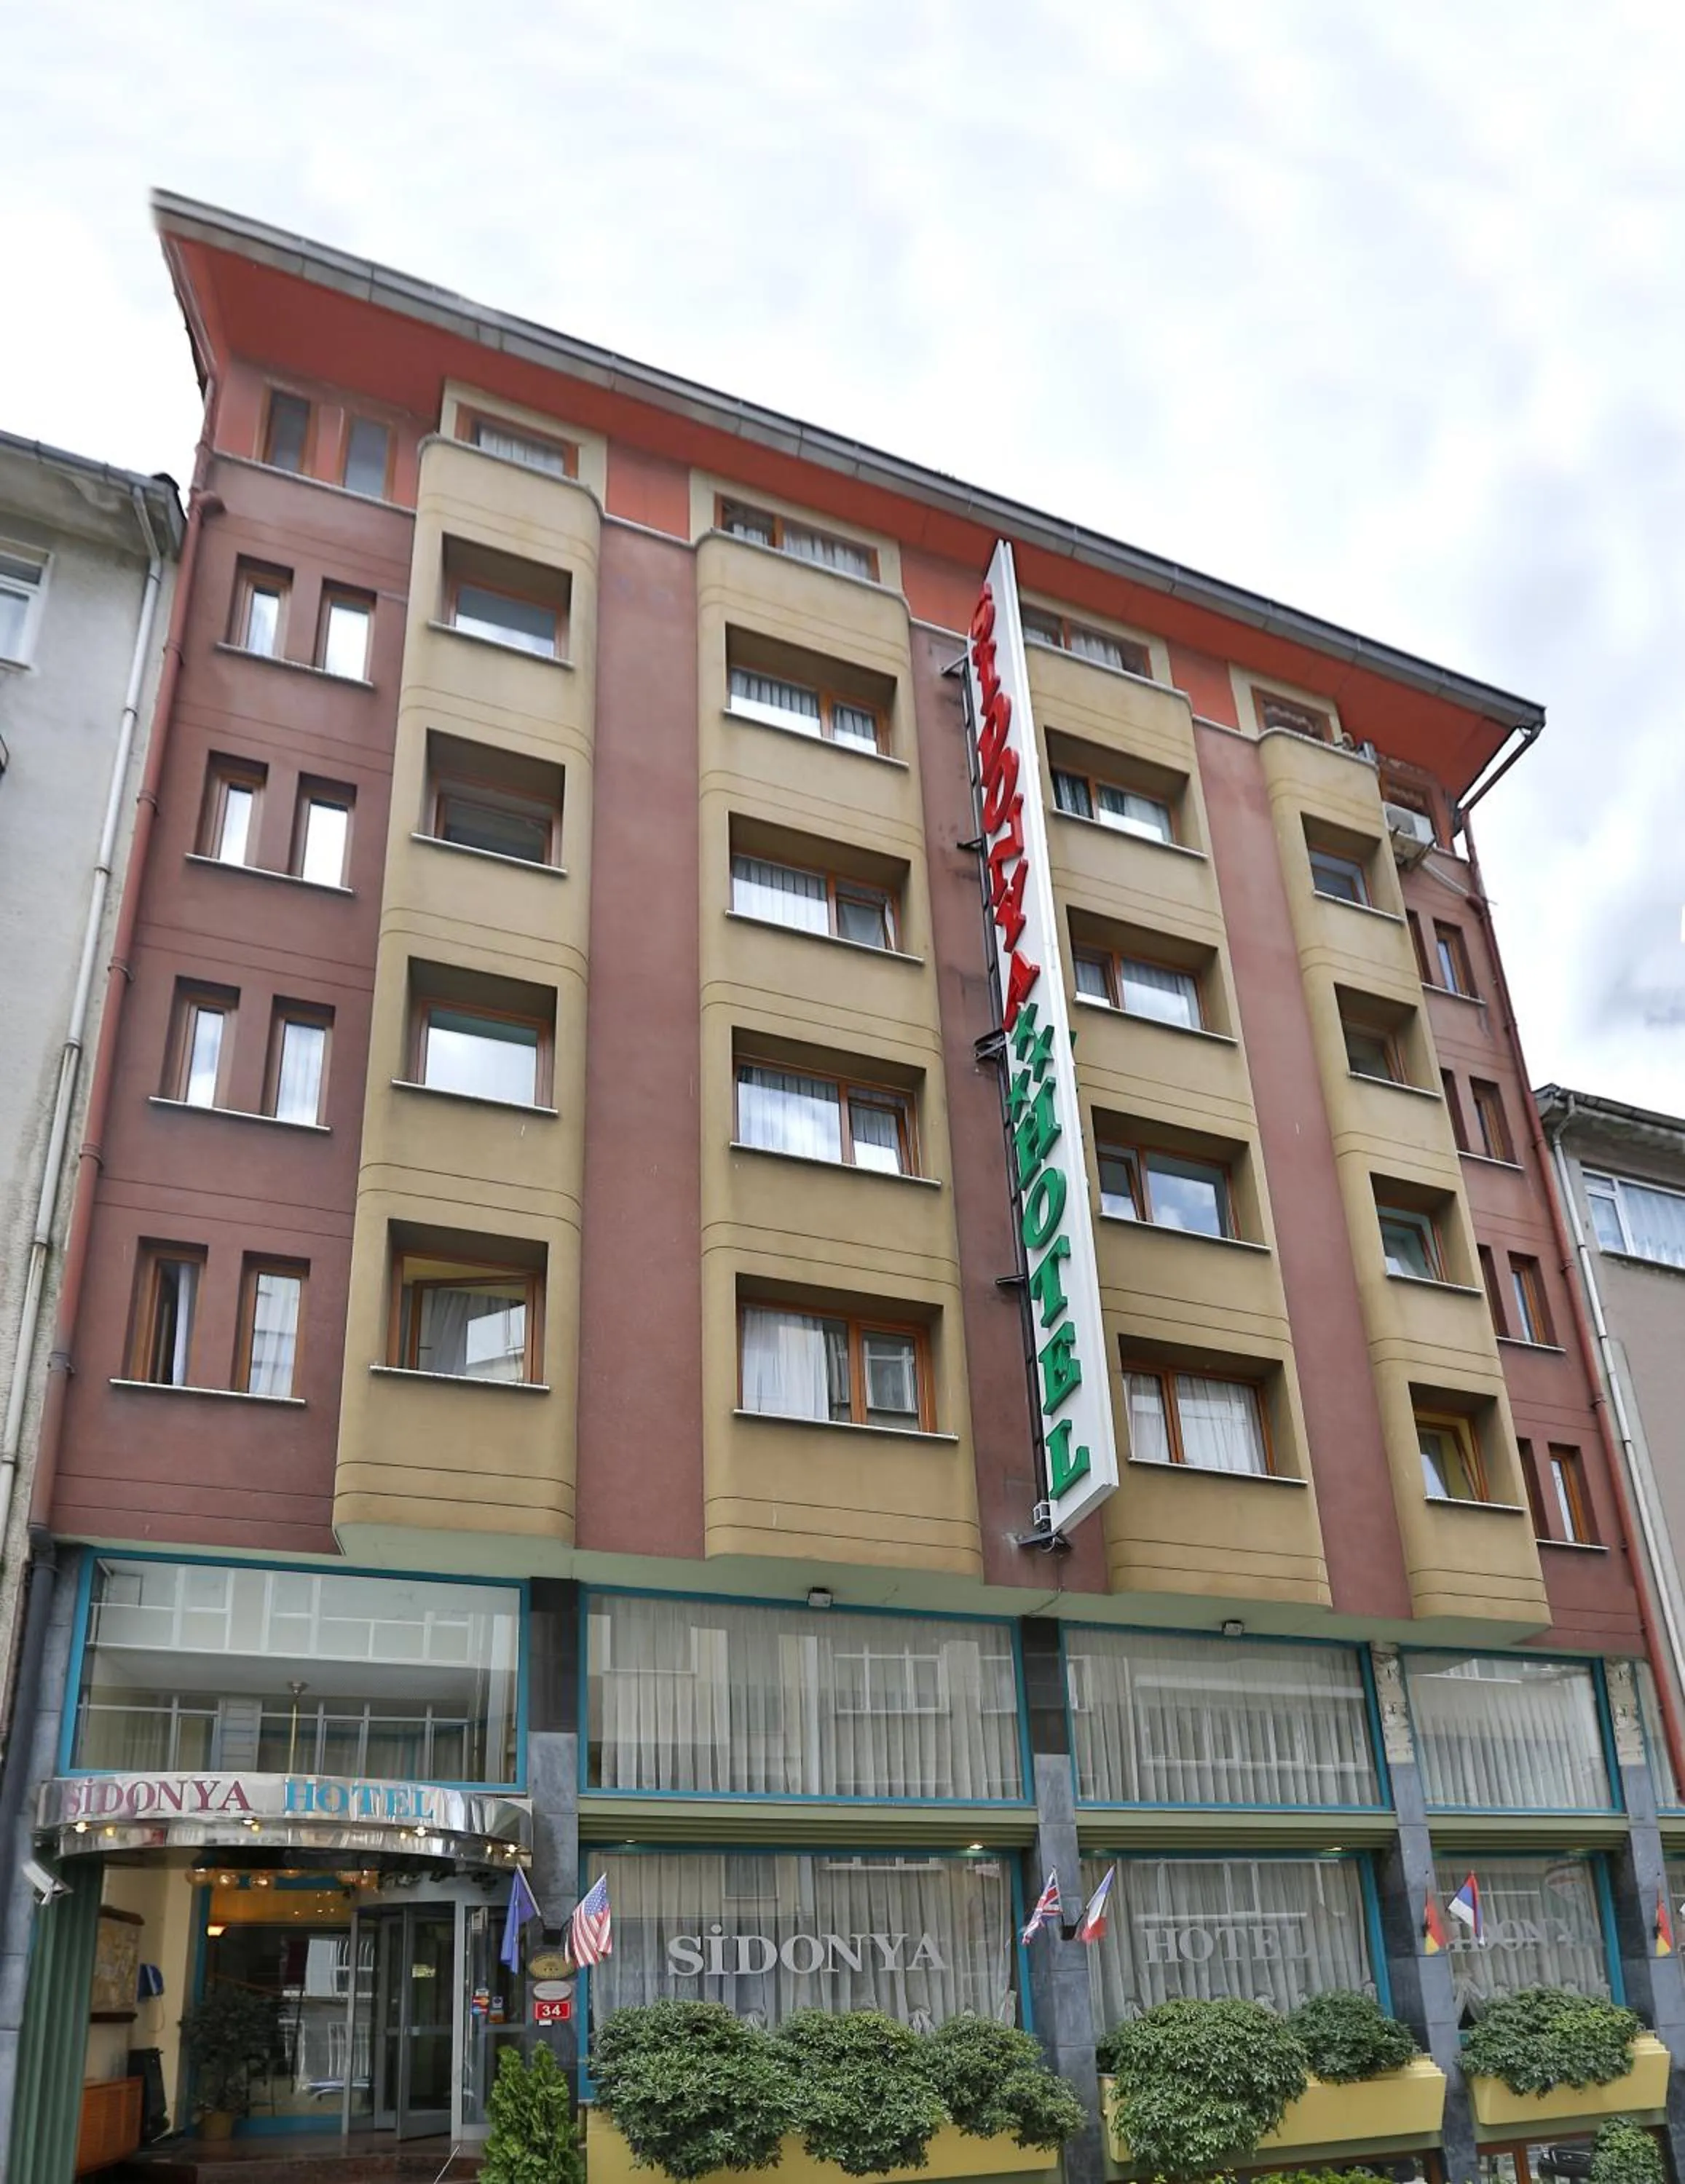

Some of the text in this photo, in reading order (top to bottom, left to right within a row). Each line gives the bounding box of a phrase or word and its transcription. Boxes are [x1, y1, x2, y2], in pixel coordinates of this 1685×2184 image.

[1014, 1076, 1091, 1501] HOTEL
[283, 1777, 434, 1819] HOTEL
[667, 1923, 948, 1977] SİDONYA
[1141, 1925, 1311, 1963] HOTEL
[541, 2003, 561, 2017] 34
